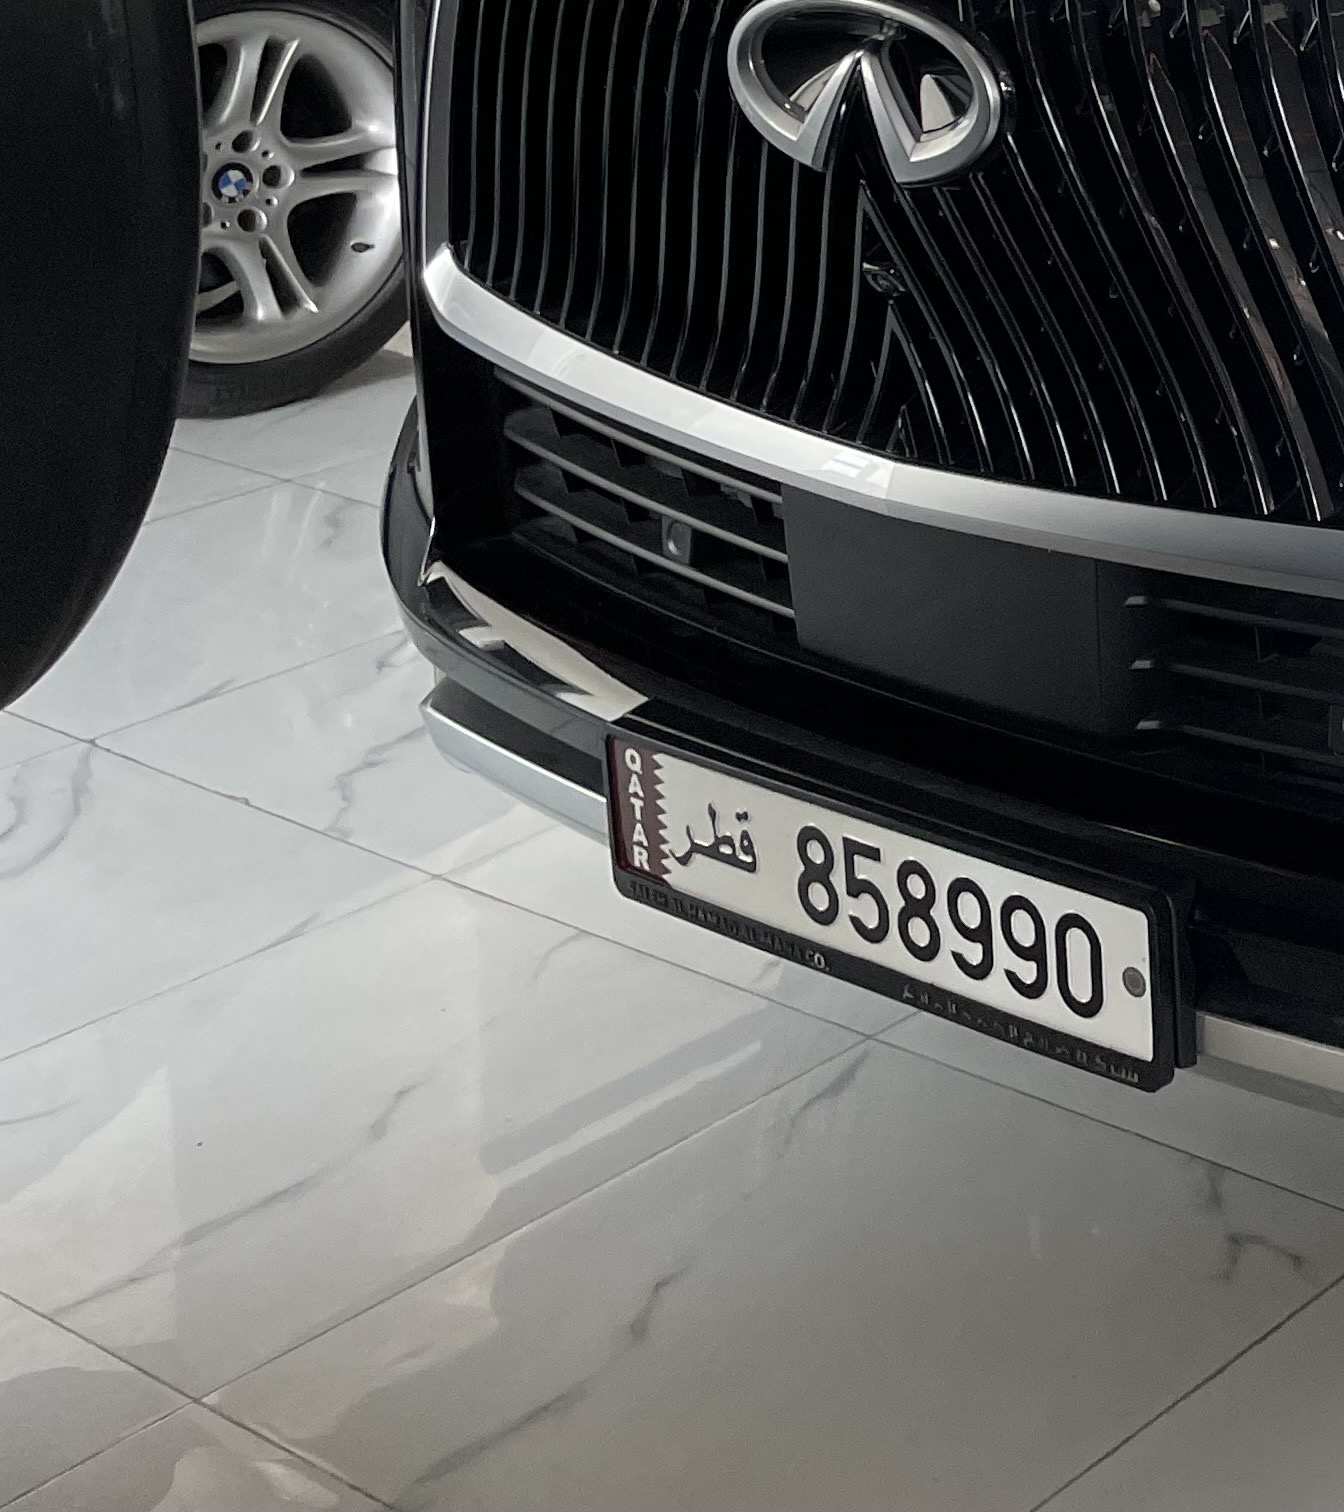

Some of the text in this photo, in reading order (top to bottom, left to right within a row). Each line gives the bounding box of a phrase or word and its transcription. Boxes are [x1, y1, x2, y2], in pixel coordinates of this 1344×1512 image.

[624, 747, 649, 872] QATAR
[669, 803, 758, 875] قطر
[796, 824, 1105, 1020] 858990
[804, 948, 832, 972] CO.
